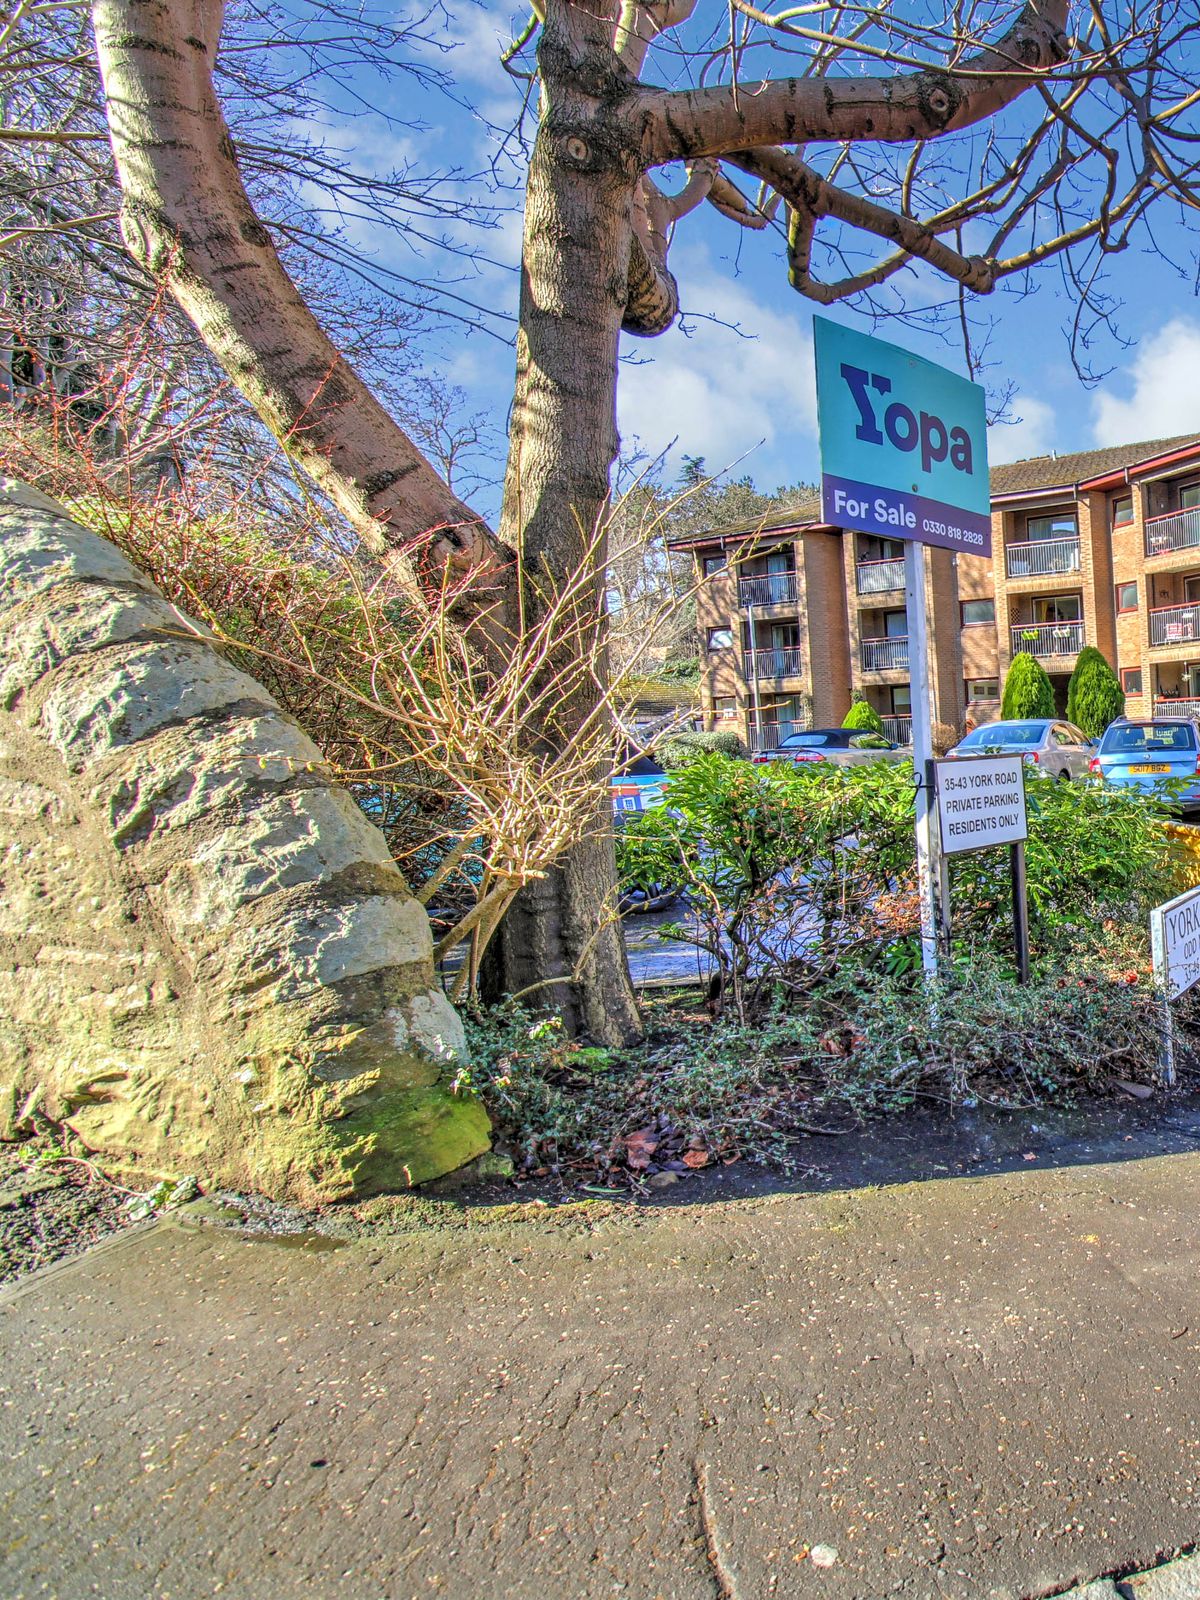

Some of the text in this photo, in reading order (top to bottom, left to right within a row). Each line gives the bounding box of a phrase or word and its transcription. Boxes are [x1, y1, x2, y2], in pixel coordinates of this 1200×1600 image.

[840, 362, 973, 475] Yopa
[834, 489, 984, 546] For Sale 0330 818 2828
[944, 771, 1018, 791] 35-43 YORK ROAD
[946, 792, 1019, 814] PRIVATE PARKING
[949, 813, 1019, 836] RESIDENTS ONLY
[1169, 901, 1200, 945] YORK
[1184, 937, 1197, 960] ODD
